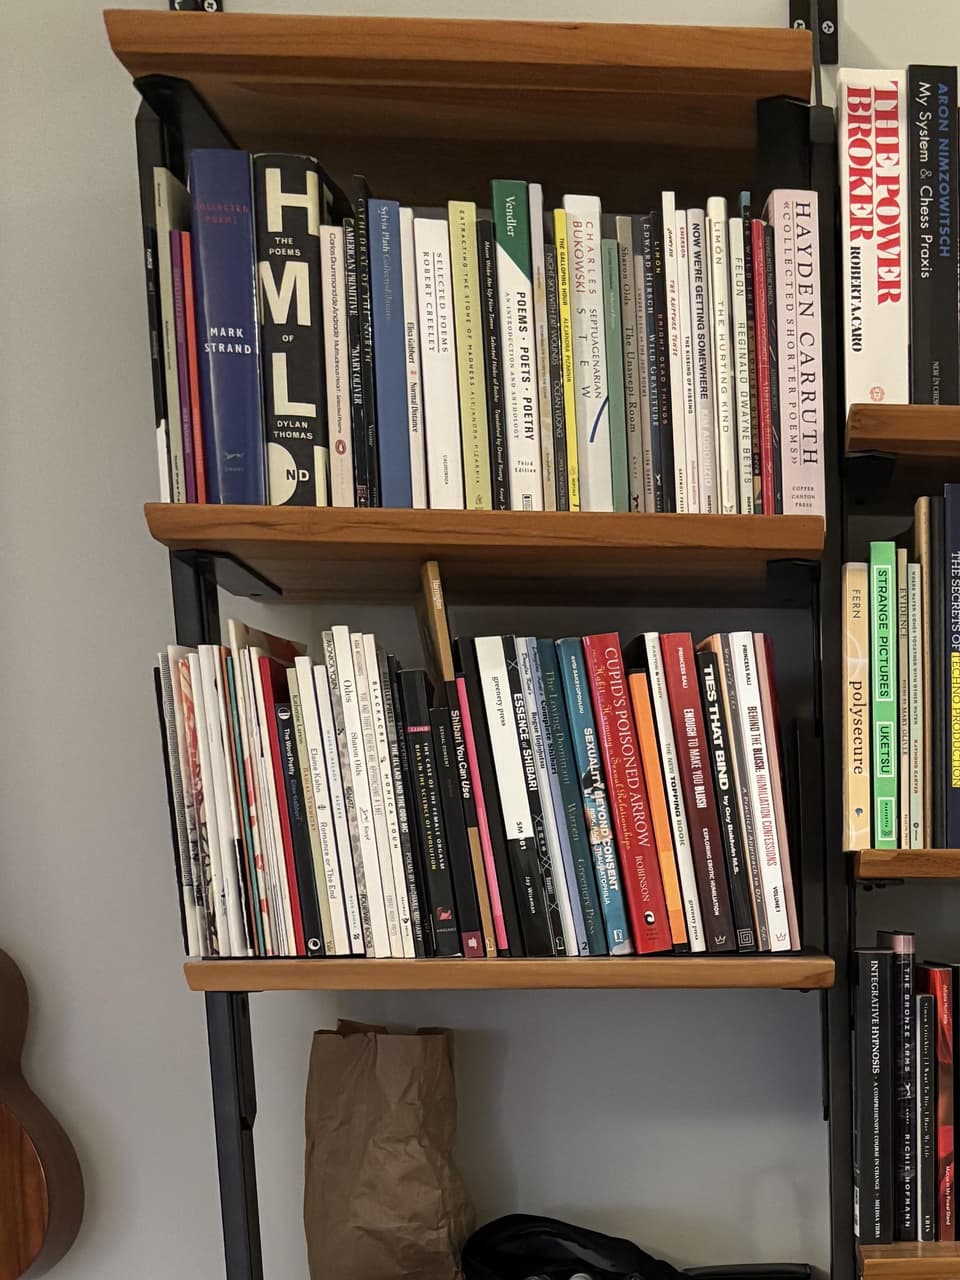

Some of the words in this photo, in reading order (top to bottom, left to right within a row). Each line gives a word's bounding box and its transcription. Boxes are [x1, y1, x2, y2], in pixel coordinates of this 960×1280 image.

[916, 82, 931, 106] My
[938, 83, 948, 131] ARON
[874, 80, 898, 169] THE
[919, 111, 932, 162] System
[847, 85, 873, 241] BROKER
[920, 169, 930, 179] &
[505, 196, 516, 237] Vendler
[920, 186, 933, 228] Chess
[939, 138, 950, 257] NIMZOWITSCH
[692, 223, 701, 247] NOW
[875, 175, 901, 305] POWER
[920, 235, 933, 279] Praxis
[694, 250, 703, 283] WE'RE
[795, 201, 814, 317] HAYDEN
[517, 292, 529, 333] POEMS
[695, 285, 705, 331] GETTING
[204, 344, 252, 354] STRAND
[210, 328, 243, 338] MARK
[519, 347, 531, 382] POETS
[697, 333, 708, 400] SOMEWHERE
[522, 397, 534, 440] POETRY
[801, 333, 818, 465] CARRUTH
[273, 431, 313, 439] THOMAS
[852, 589, 861, 619] FERN
[878, 570, 889, 630] STRANGE
[605, 647, 629, 706] CUPID'S
[703, 664, 717, 702] TIES
[879, 636, 890, 697] PICTURES
[709, 704, 724, 747] THAT
[850, 681, 866, 775] polysecure
[615, 710, 640, 788] POISONED
[716, 751, 729, 790] BIND
[879, 726, 891, 773] UKETSU
[628, 793, 650, 847] ARROW
[635, 855, 650, 902] ROBINSON
